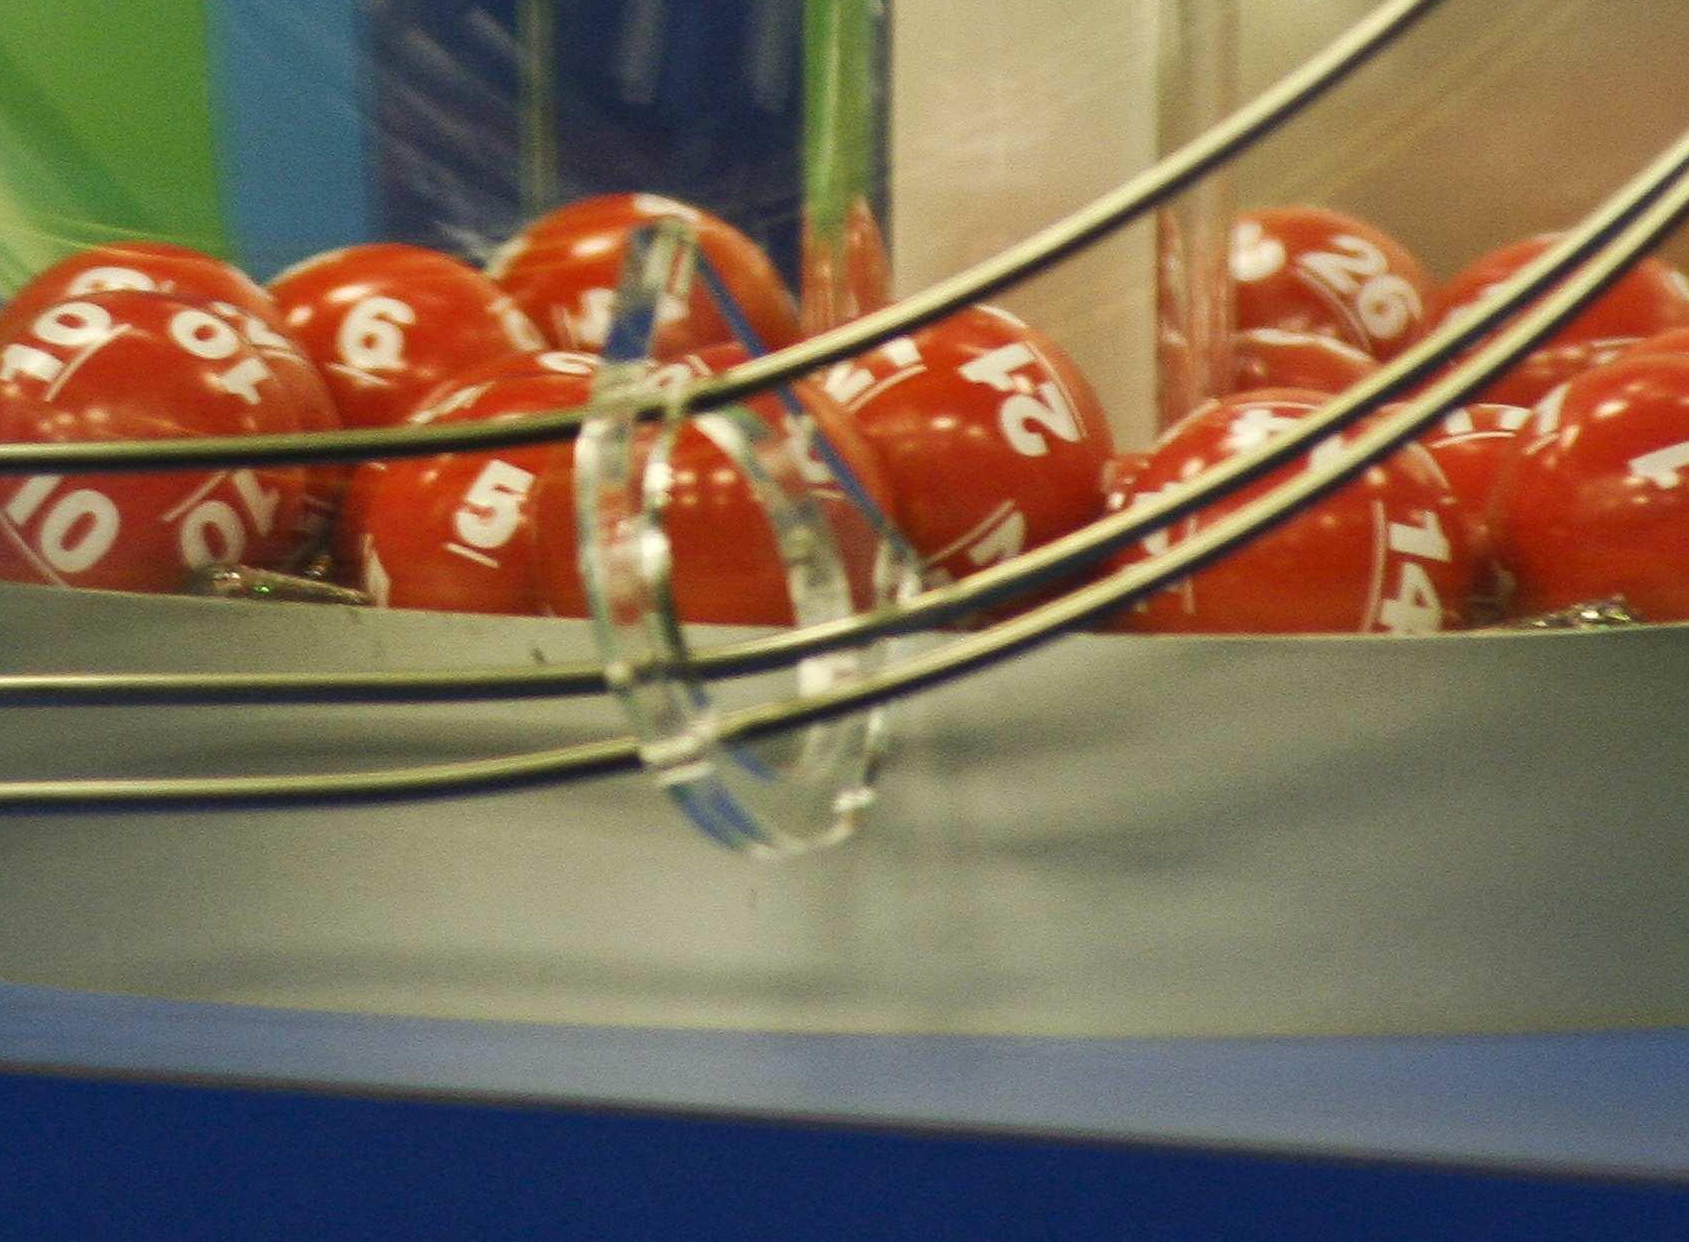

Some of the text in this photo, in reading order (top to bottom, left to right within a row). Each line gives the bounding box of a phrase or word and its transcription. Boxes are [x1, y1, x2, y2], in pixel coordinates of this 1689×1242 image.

[339, 297, 416, 370] 6
[1297, 234, 1423, 339] 26
[0, 302, 112, 382] 10
[170, 309, 273, 405] 10
[957, 341, 1082, 457] 21
[455, 459, 536, 549] 5
[1381, 510, 1452, 631] 14
